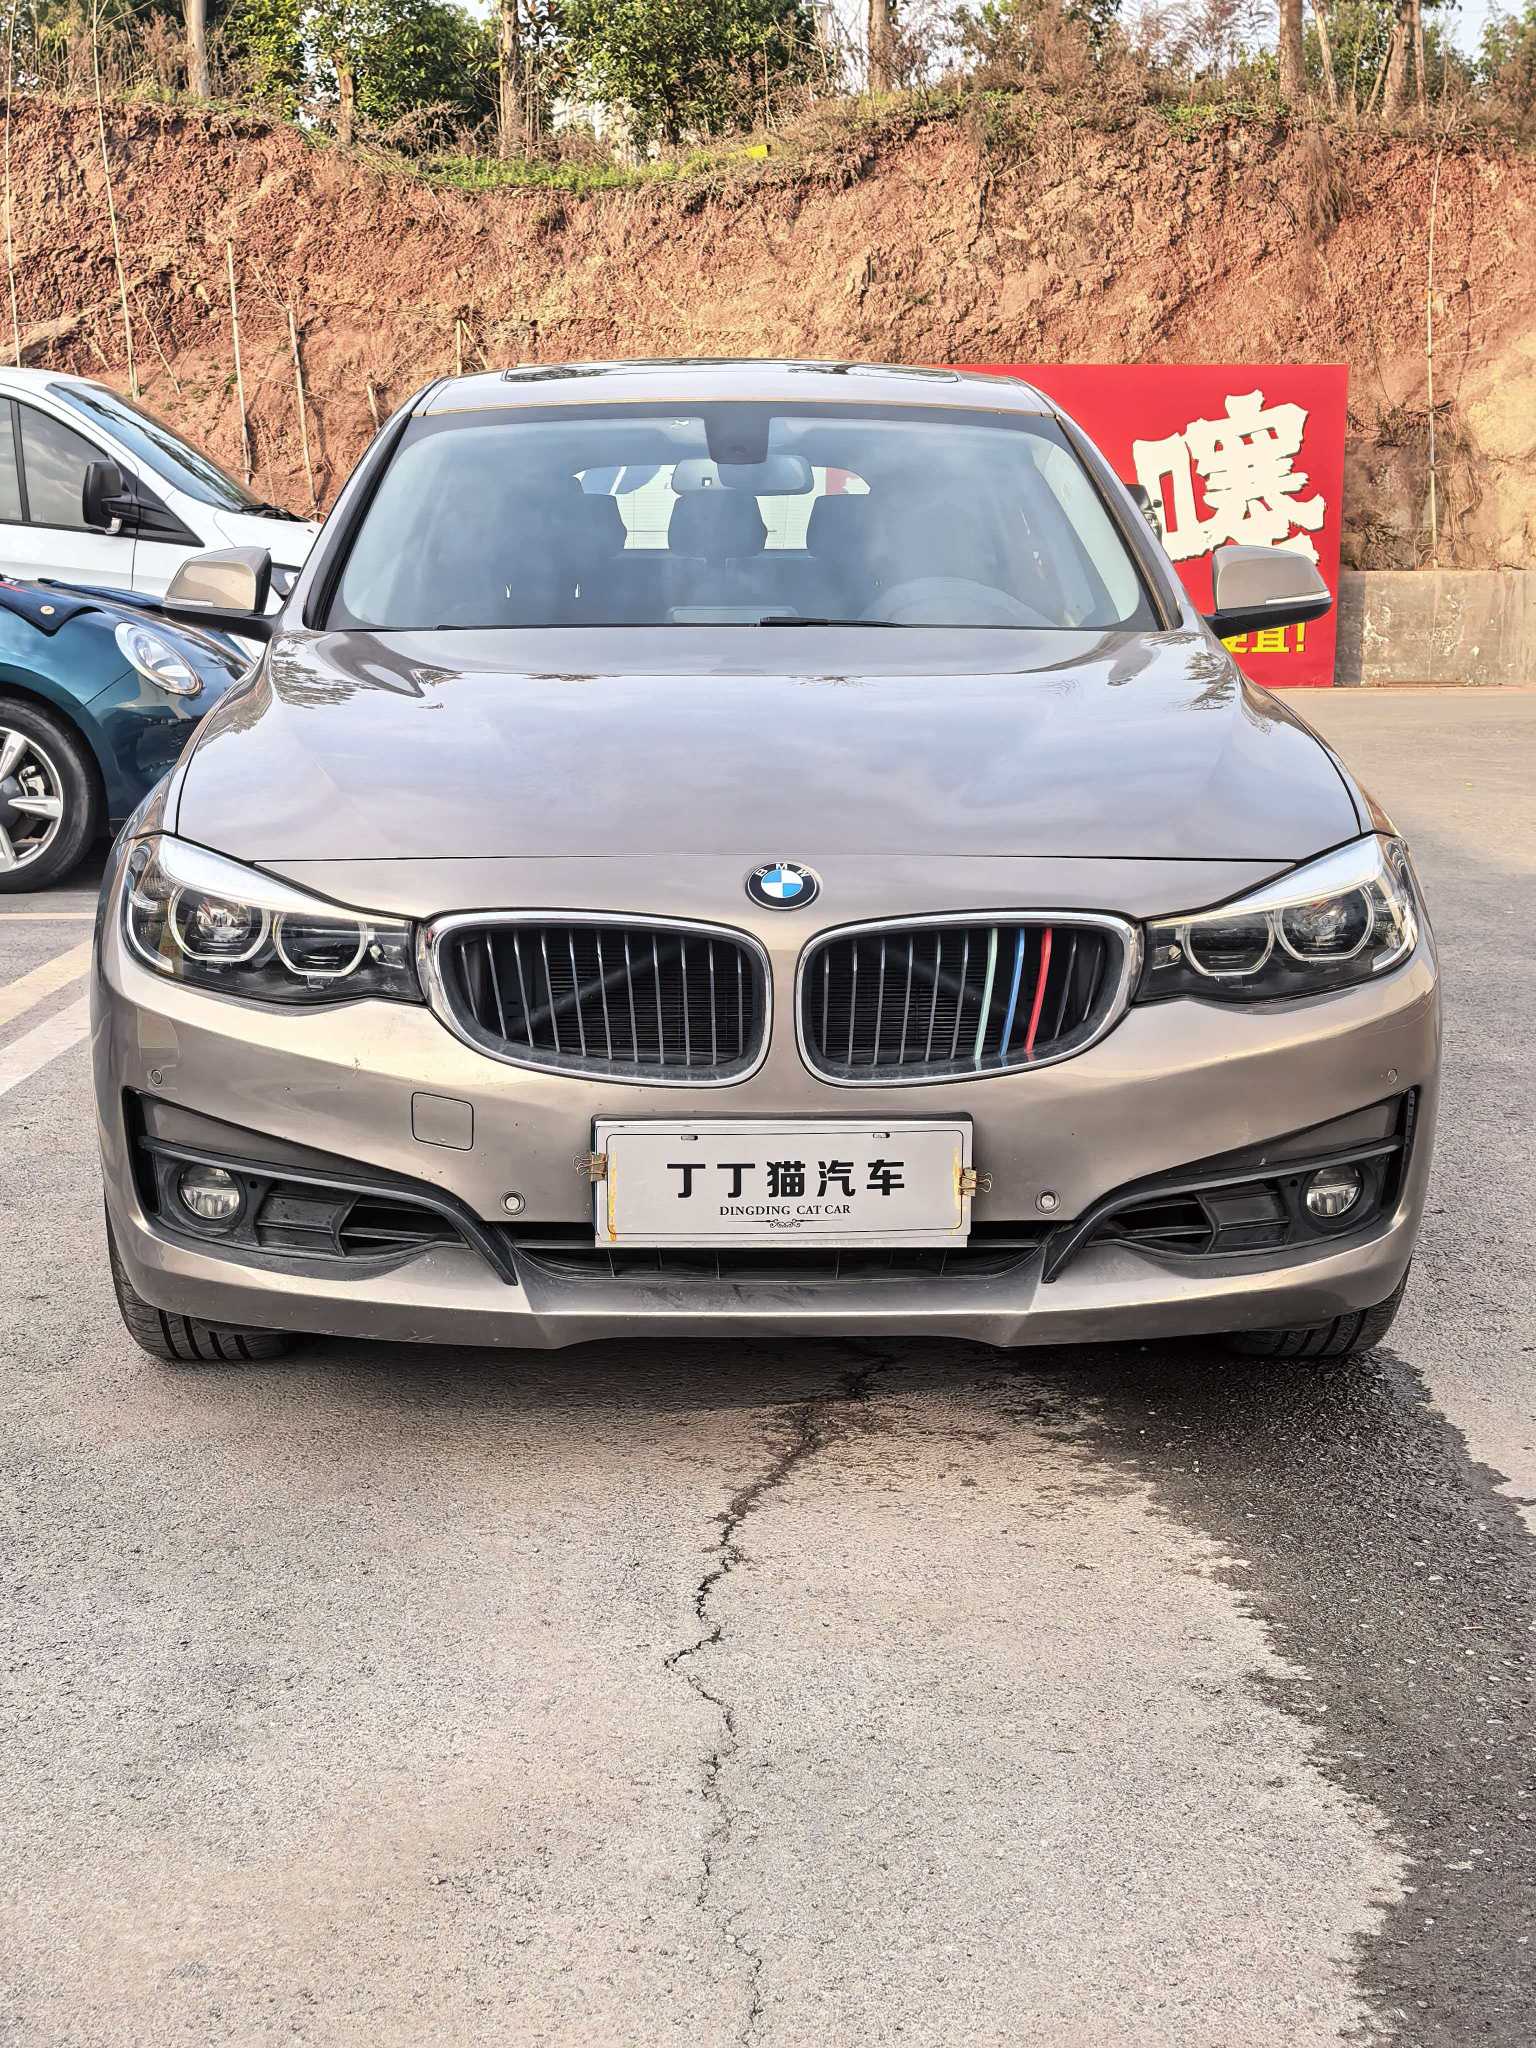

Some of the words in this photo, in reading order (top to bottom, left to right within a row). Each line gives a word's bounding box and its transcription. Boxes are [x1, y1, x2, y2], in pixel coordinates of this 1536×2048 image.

[755, 863, 812, 877] BMW
[667, 1160, 905, 1199] 丁丁猫汽车
[719, 1205, 791, 1217] DINGDING
[797, 1205, 822, 1216] CAT
[824, 1204, 851, 1216] CAR
